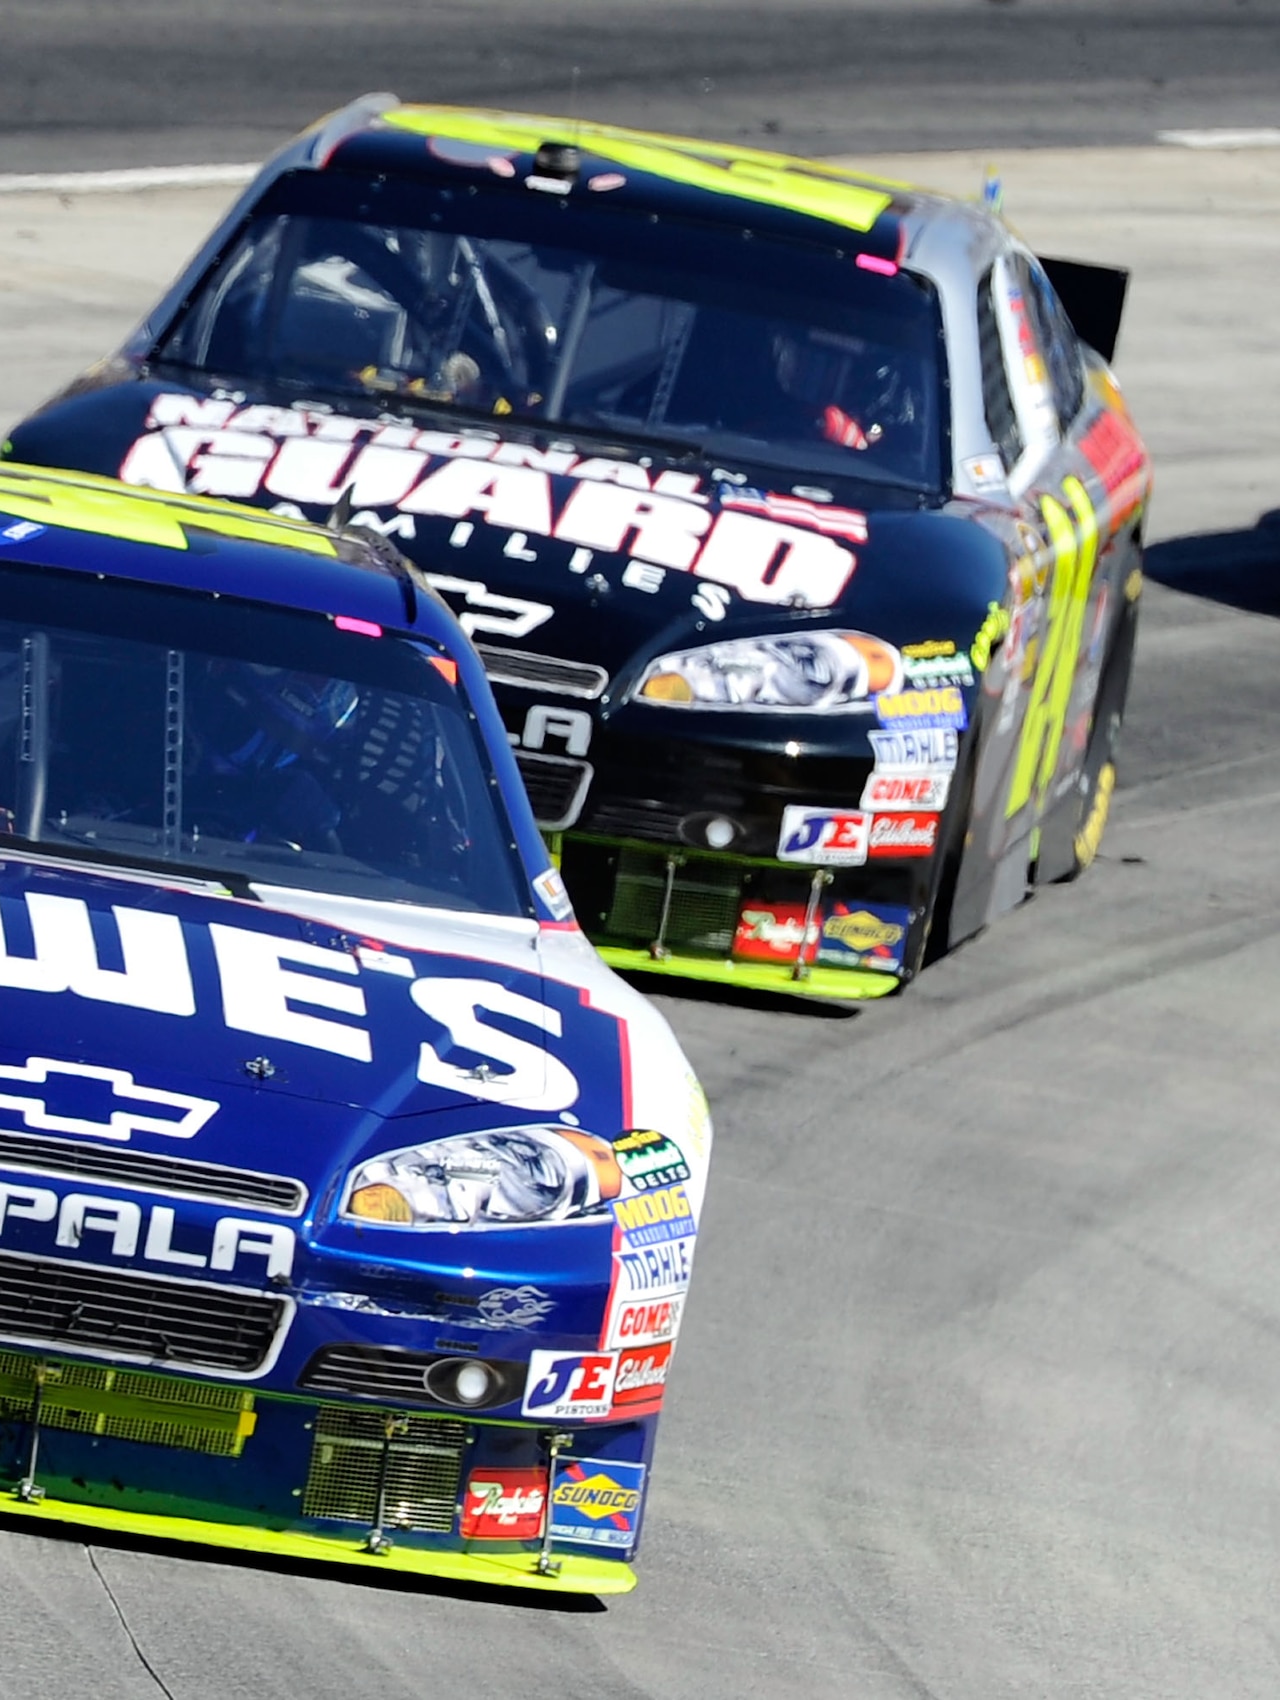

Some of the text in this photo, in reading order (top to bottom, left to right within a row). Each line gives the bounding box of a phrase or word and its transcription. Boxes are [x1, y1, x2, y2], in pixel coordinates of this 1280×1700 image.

[146, 393, 710, 505] NATIONAL
[120, 425, 857, 609] GUARD
[268, 502, 731, 622] AMILIES
[877, 686, 961, 718] MOOG
[872, 778, 931, 801] COMP
[784, 813, 864, 853] JE
[632, 1164, 689, 1190] BELTS
[613, 1185, 690, 1232] MOOG
[619, 1302, 671, 1337] COMP
[526, 1356, 613, 1410] JE
[554, 1403, 610, 1415] PISTONS
[557, 1486, 637, 1509] SUNOCO
